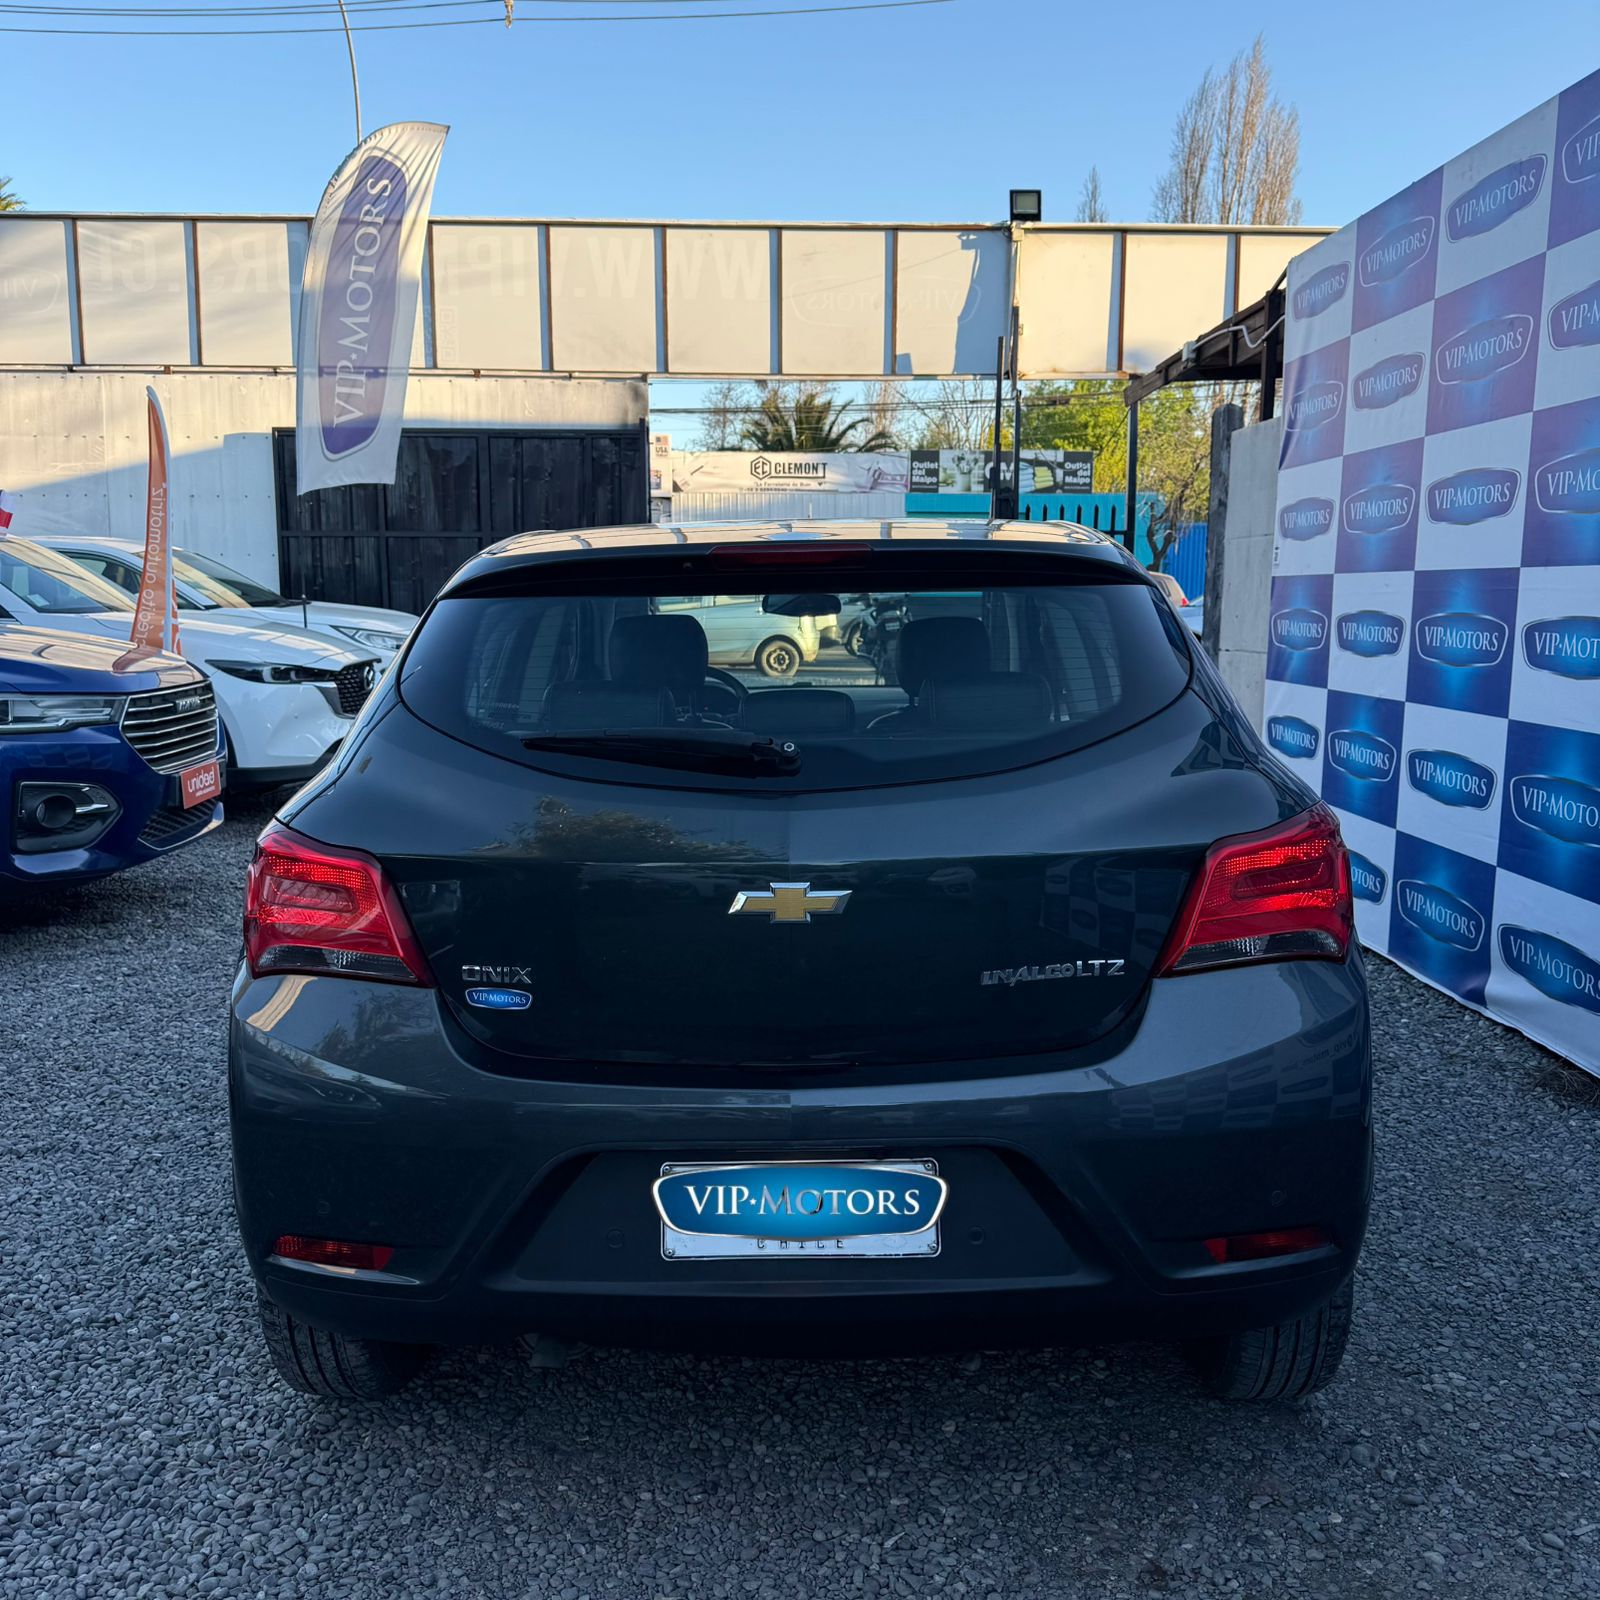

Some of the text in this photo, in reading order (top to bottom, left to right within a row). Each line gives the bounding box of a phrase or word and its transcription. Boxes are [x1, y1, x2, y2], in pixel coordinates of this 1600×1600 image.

[774, 462, 828, 475] CLEMONT
[912, 461, 938, 469] Outlet
[912, 475, 938, 484] Maipo
[1064, 475, 1091, 485] Maipo
[1076, 959, 1125, 976] LTZ
[462, 964, 532, 984] ONIX
